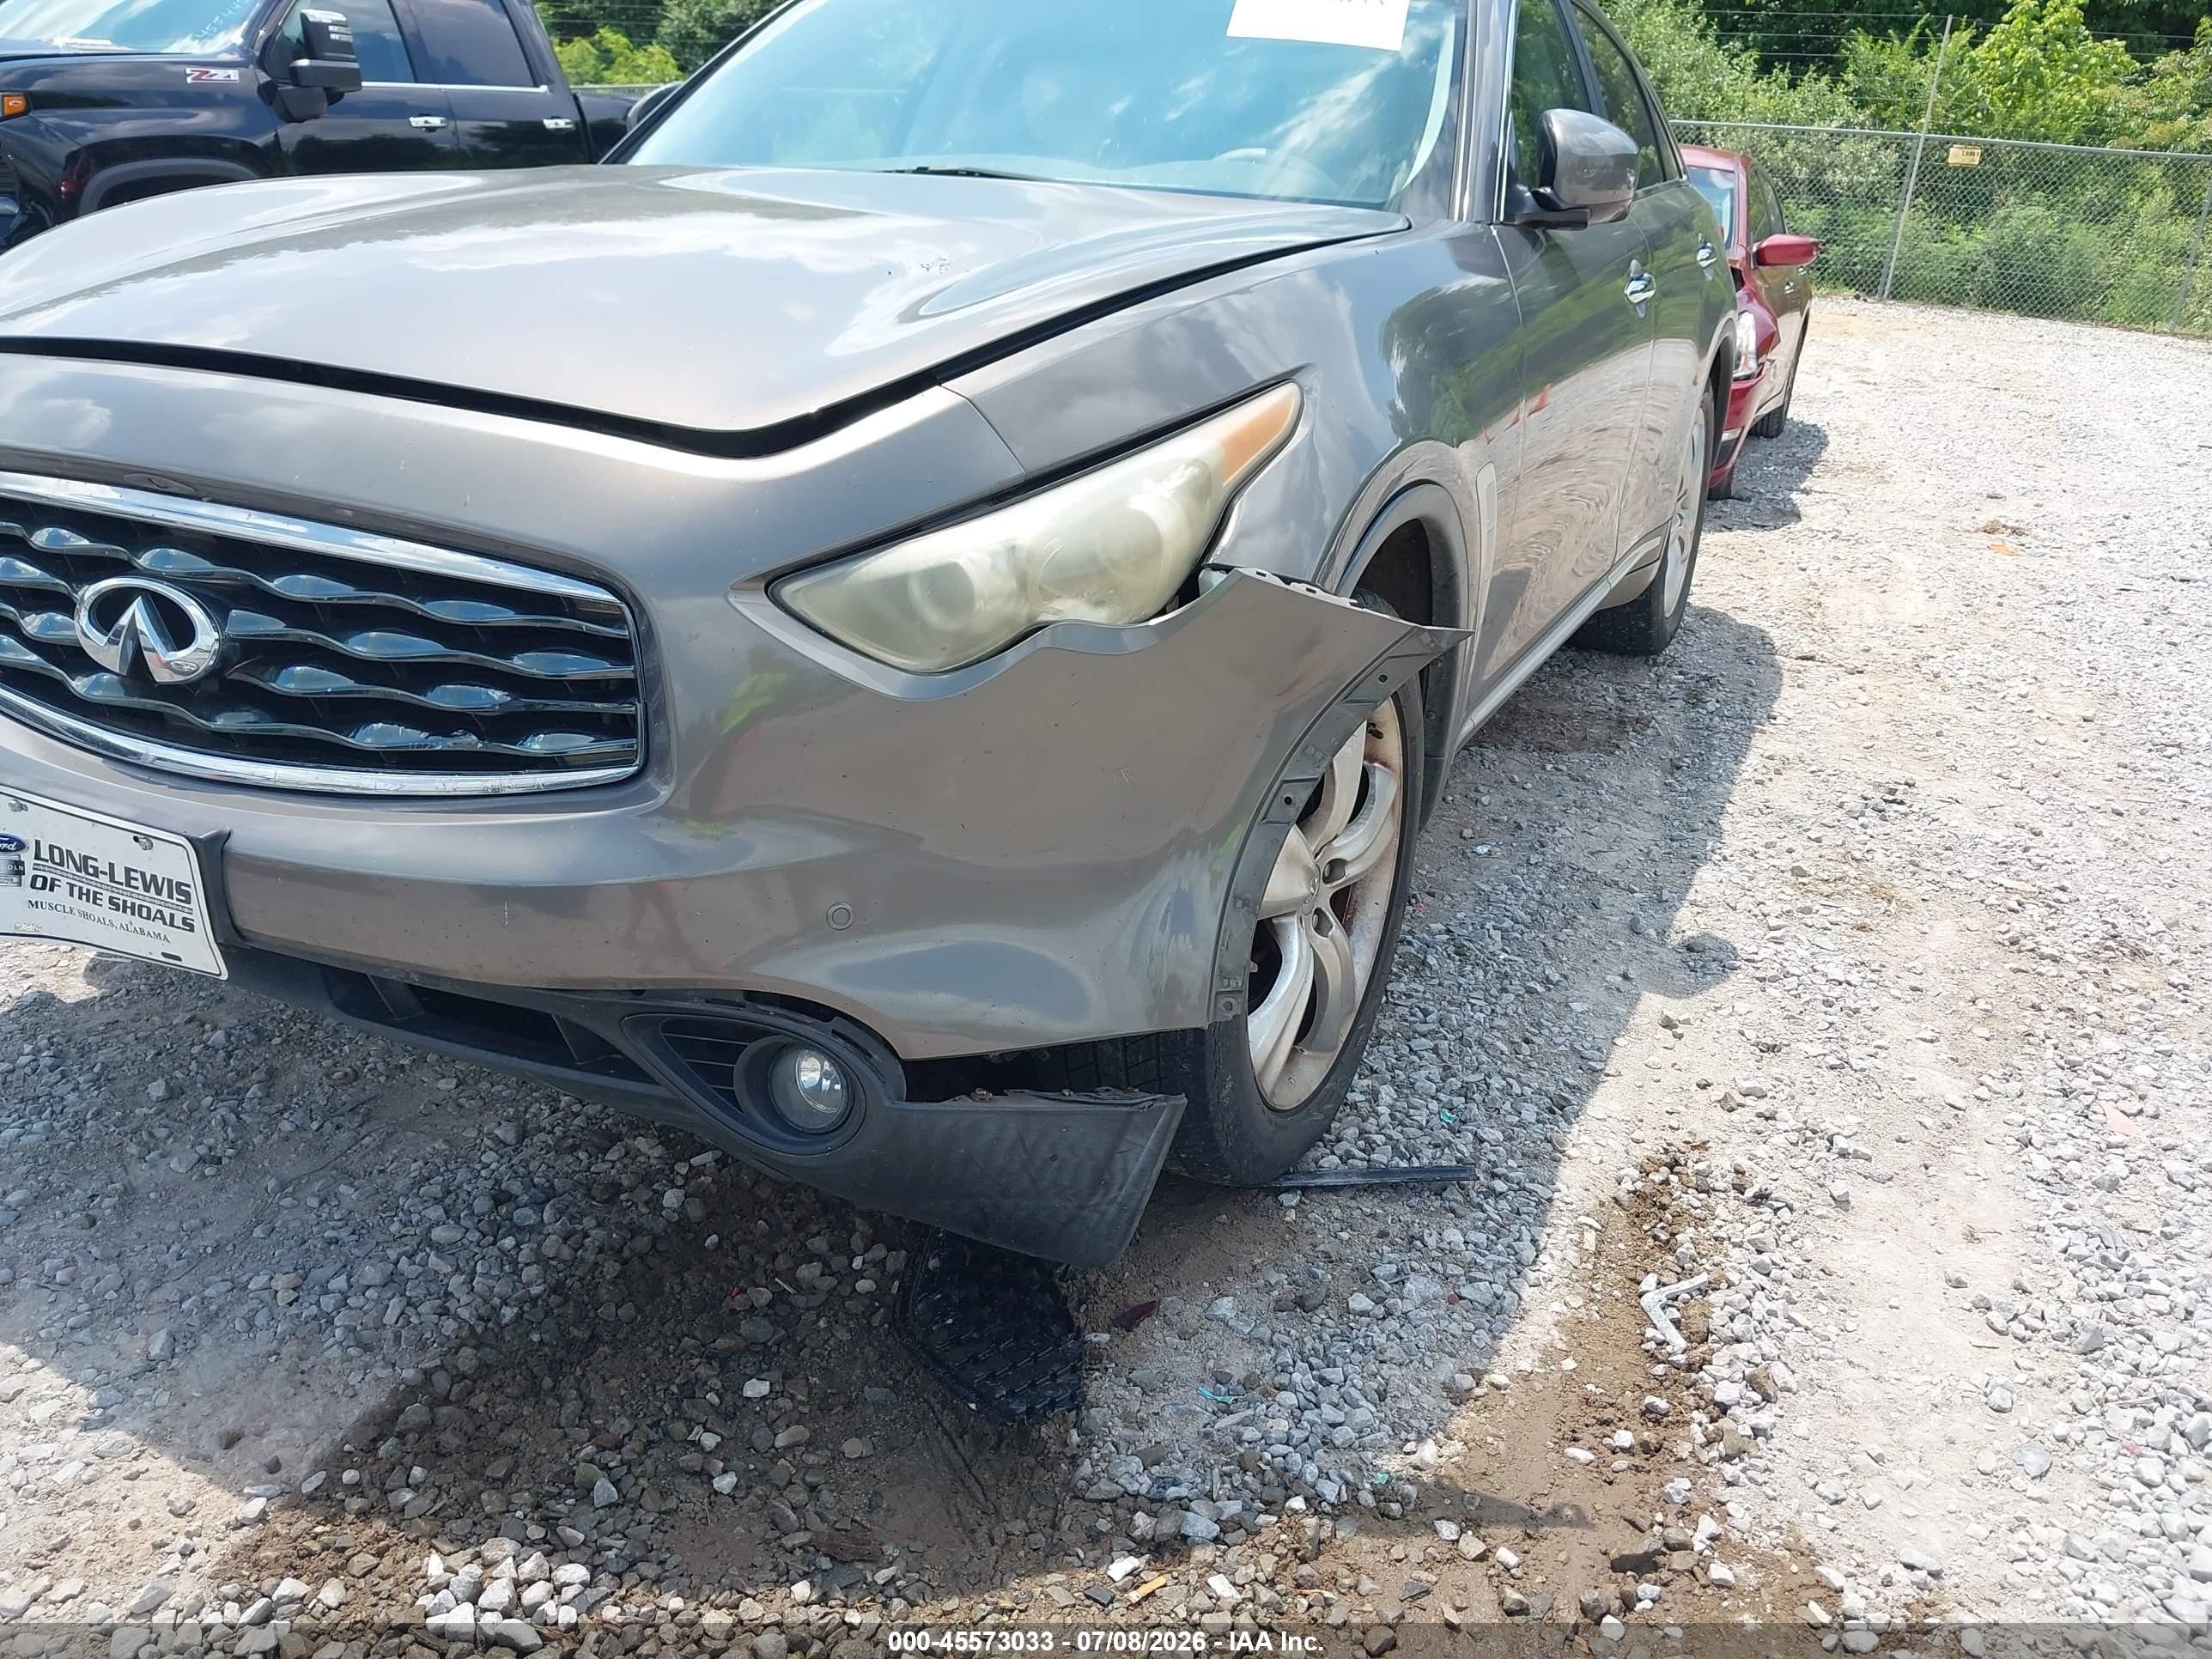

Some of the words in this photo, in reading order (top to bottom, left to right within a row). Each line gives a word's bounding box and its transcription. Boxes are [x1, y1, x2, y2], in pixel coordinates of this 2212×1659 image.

[185, 68, 240, 83] Z71
[34, 839, 191, 904] LONG-LEWIS
[27, 899, 76, 917] MUSCLE
[77, 907, 118, 930] SHOALS,
[118, 921, 171, 943] ALABAMA
[30, 874, 61, 891] OF
[66, 881, 103, 907] THE
[108, 895, 195, 933] SHOALS
